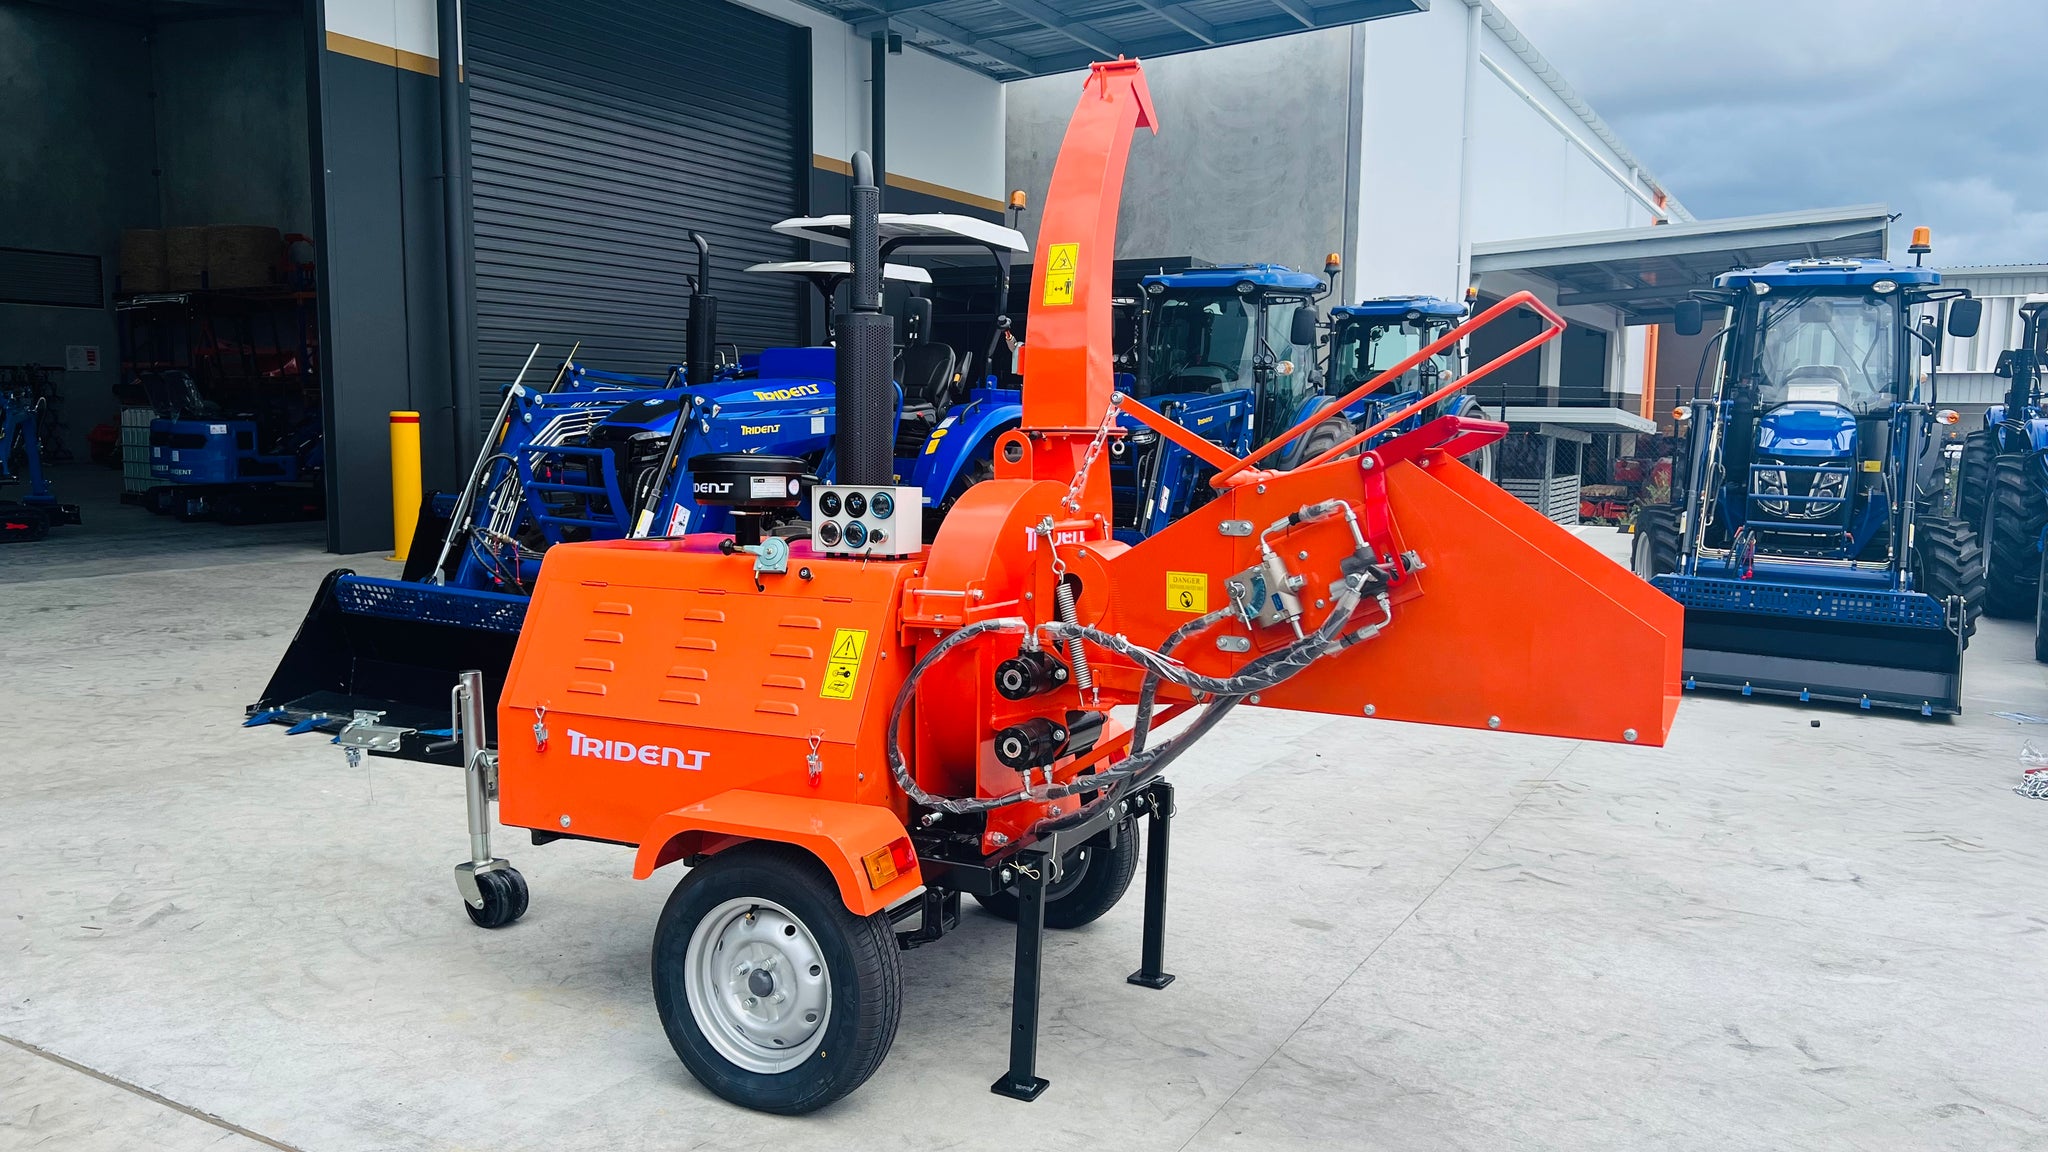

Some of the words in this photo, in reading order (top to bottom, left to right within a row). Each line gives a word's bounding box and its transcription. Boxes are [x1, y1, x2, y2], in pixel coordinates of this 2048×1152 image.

[753, 383, 819, 401] TRIDENT
[741, 424, 780, 436] TRIDENT
[1173, 576, 1201, 585] DANGER
[567, 728, 711, 771] TRIDENT
